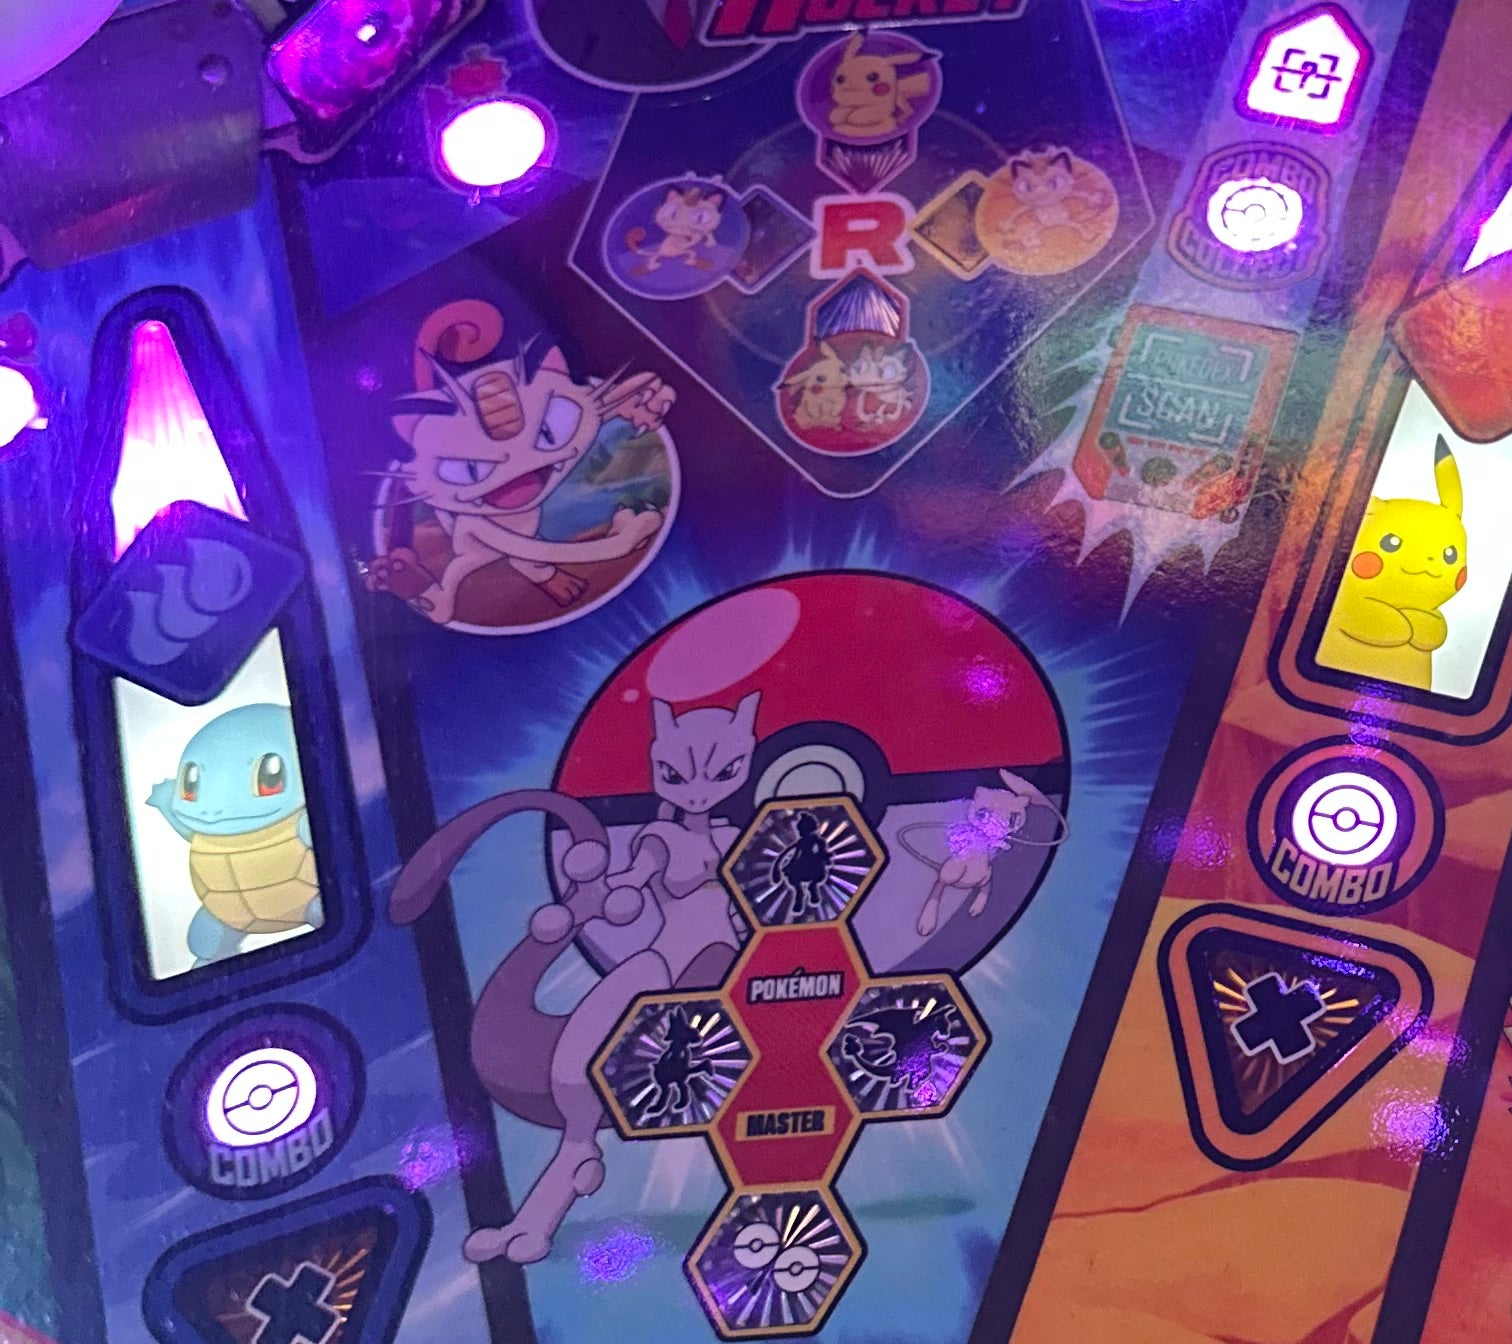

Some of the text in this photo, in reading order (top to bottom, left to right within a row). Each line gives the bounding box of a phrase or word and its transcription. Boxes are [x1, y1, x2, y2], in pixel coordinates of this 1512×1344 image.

[1208, 152, 1316, 205] COMBO
[817, 200, 906, 270] R
[1135, 383, 1222, 429] SCAN
[1270, 836, 1394, 906] COMBO
[208, 1107, 334, 1188] COMBO
[746, 1109, 826, 1137] MASTER
